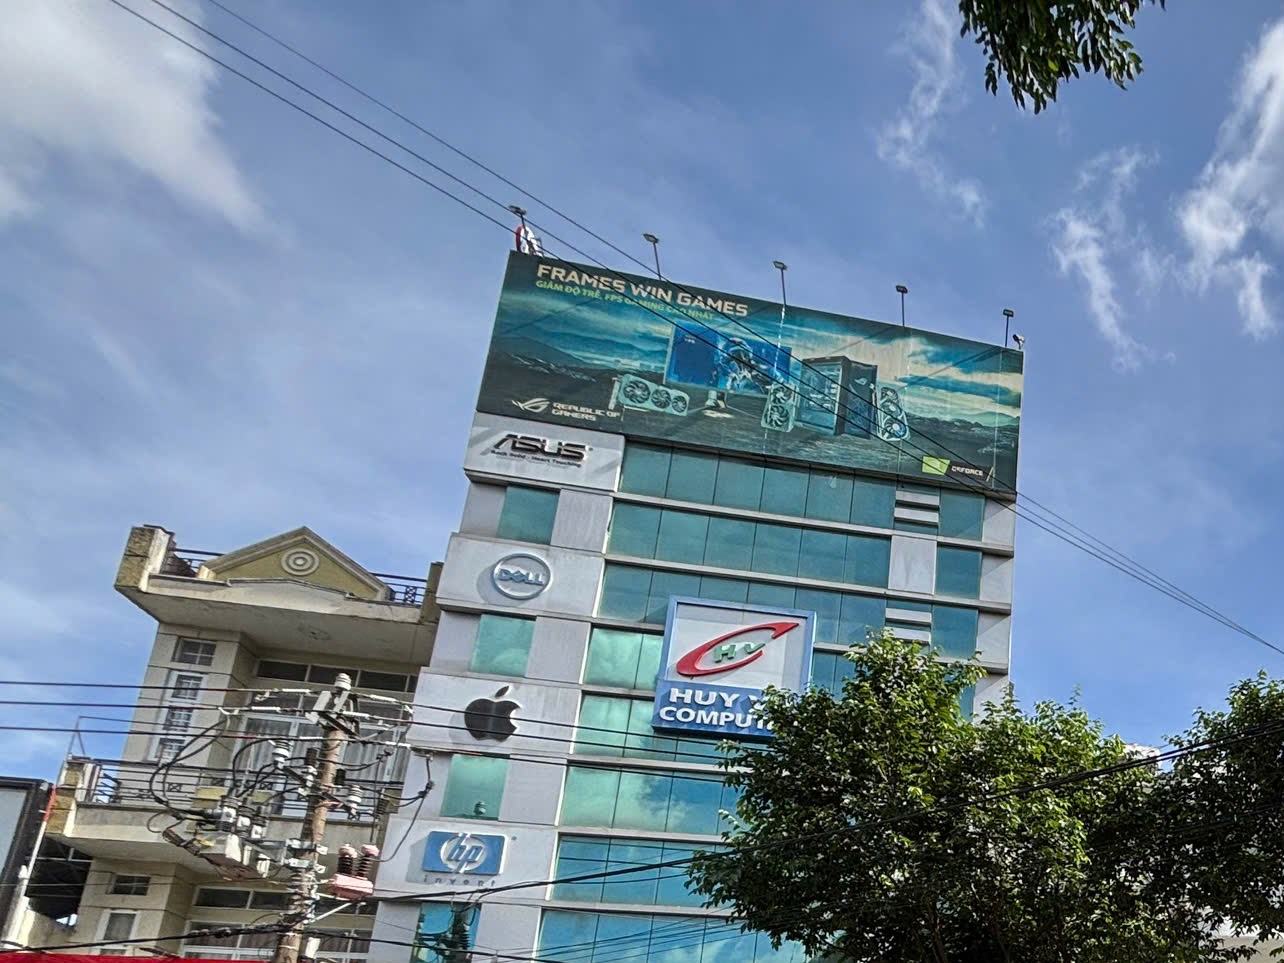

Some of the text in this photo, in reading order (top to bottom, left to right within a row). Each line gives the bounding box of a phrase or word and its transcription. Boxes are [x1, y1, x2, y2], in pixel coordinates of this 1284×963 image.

[537, 264, 748, 317] FRAMES WIN GAMES
[552, 408, 596, 421] GAMERS
[553, 402, 604, 416] REPUBLIC
[494, 433, 588, 461] ASUS
[498, 567, 547, 586] DELL
[669, 687, 740, 708] HUY
[446, 833, 484, 873] hp
[423, 874, 496, 887] invent
